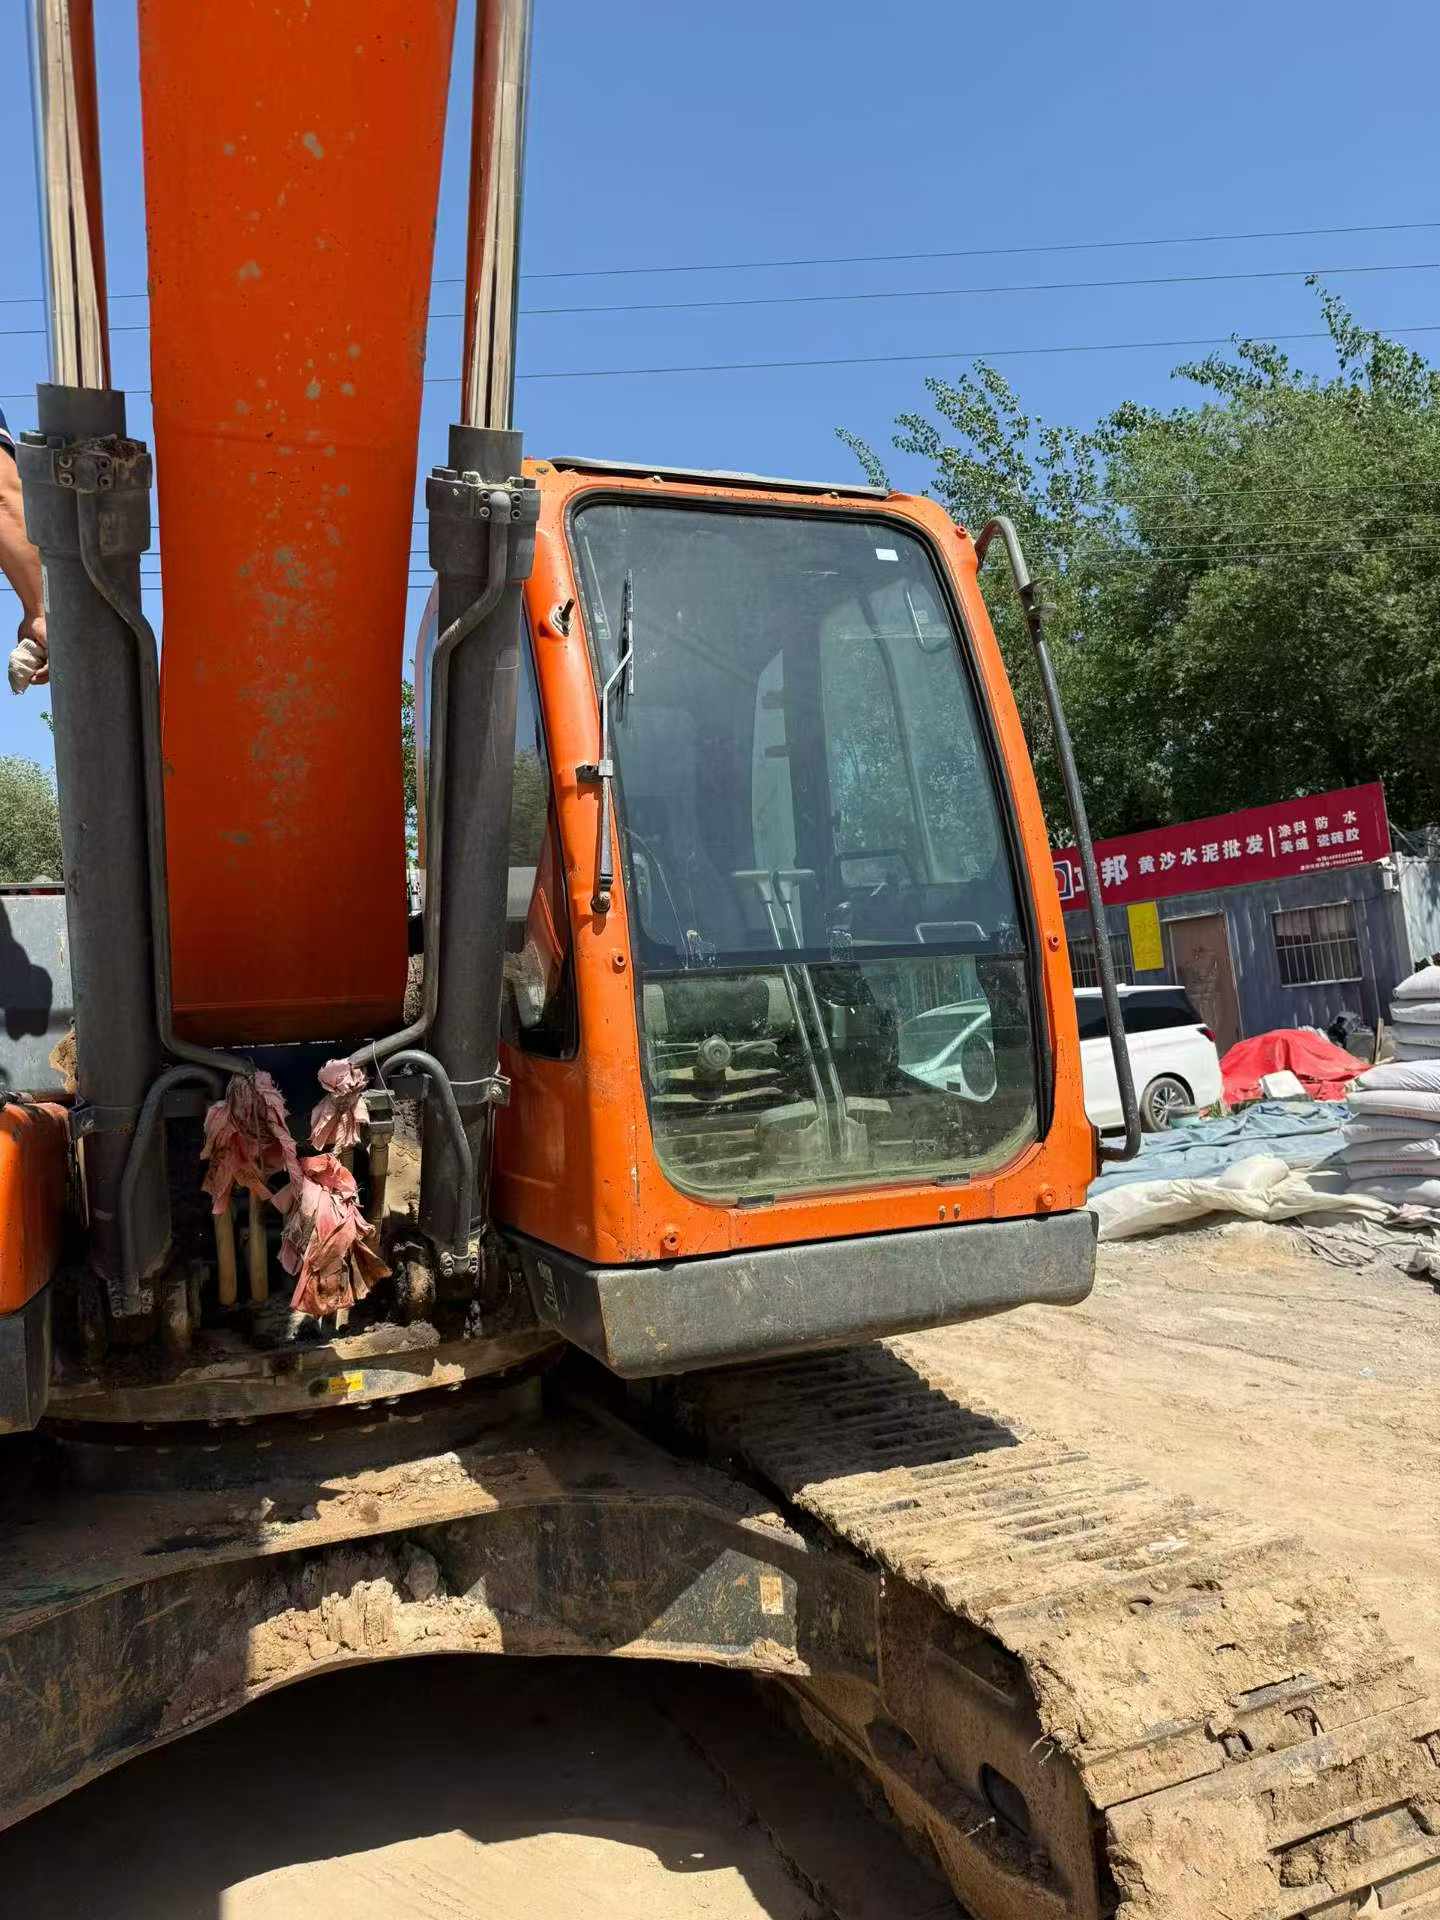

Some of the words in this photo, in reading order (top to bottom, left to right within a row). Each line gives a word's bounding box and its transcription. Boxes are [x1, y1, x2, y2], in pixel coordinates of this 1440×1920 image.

[1278, 820, 1307, 838] 涂料
[1317, 827, 1360, 848] 瓷砖胶
[1138, 834, 1264, 875] 黄沙水泥批发
